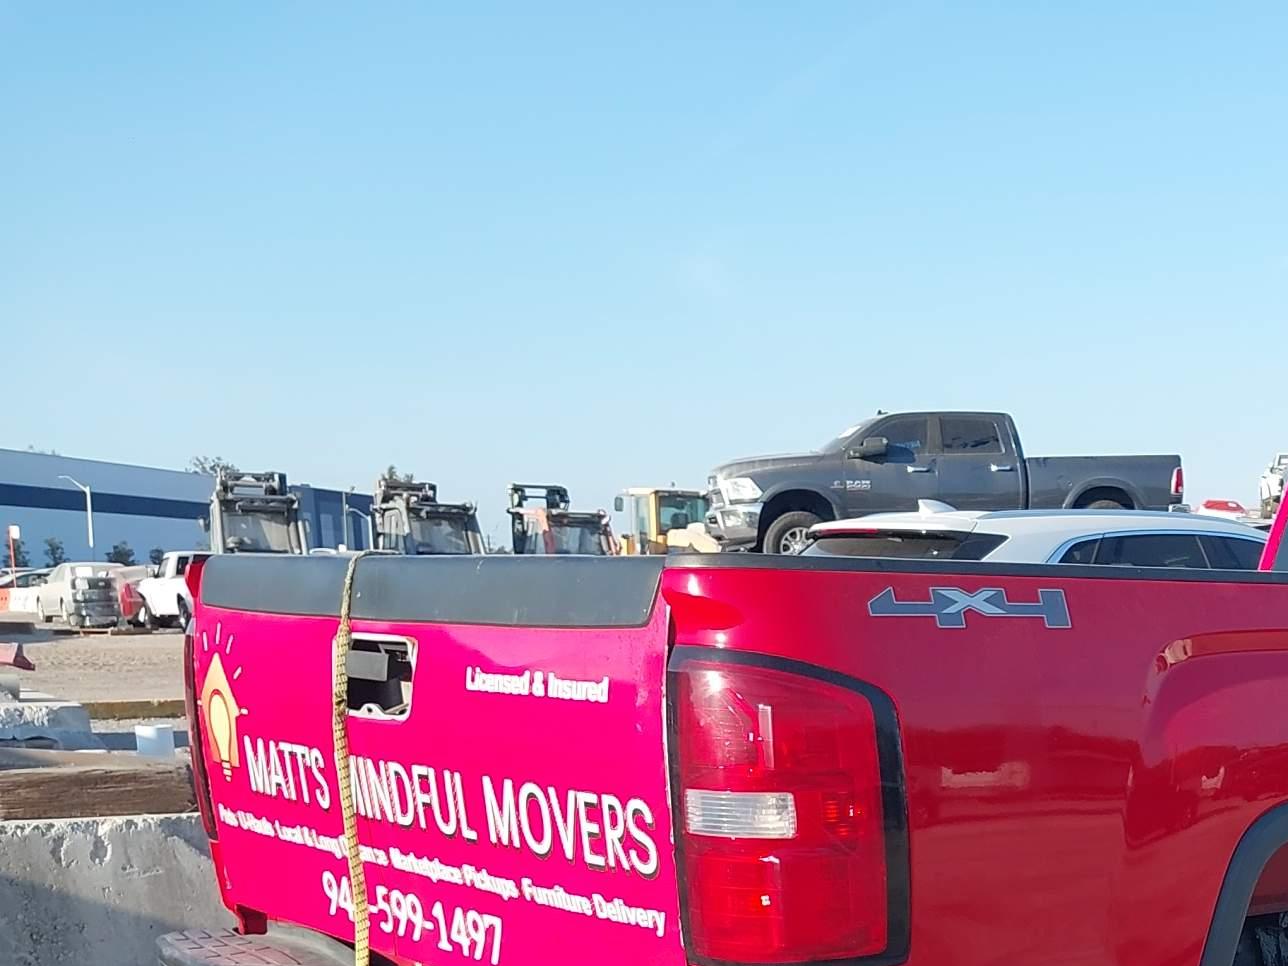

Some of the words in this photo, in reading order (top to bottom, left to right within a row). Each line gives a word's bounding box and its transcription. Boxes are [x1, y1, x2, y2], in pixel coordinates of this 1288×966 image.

[465, 665, 531, 696] Licensed
[532, 670, 545, 697] &
[547, 671, 610, 703] Insured
[243, 734, 331, 810] MATT'S
[481, 775, 660, 879] MOVERS
[274, 819, 304, 845] Local
[311, 828, 344, 860] Long
[388, 846, 464, 883] Marketplace
[461, 863, 520, 901] Pickups
[520, 876, 593, 916] Furniture
[591, 892, 667, 938] Delivery
[321, 870, 503, 966] 94-599-1497
